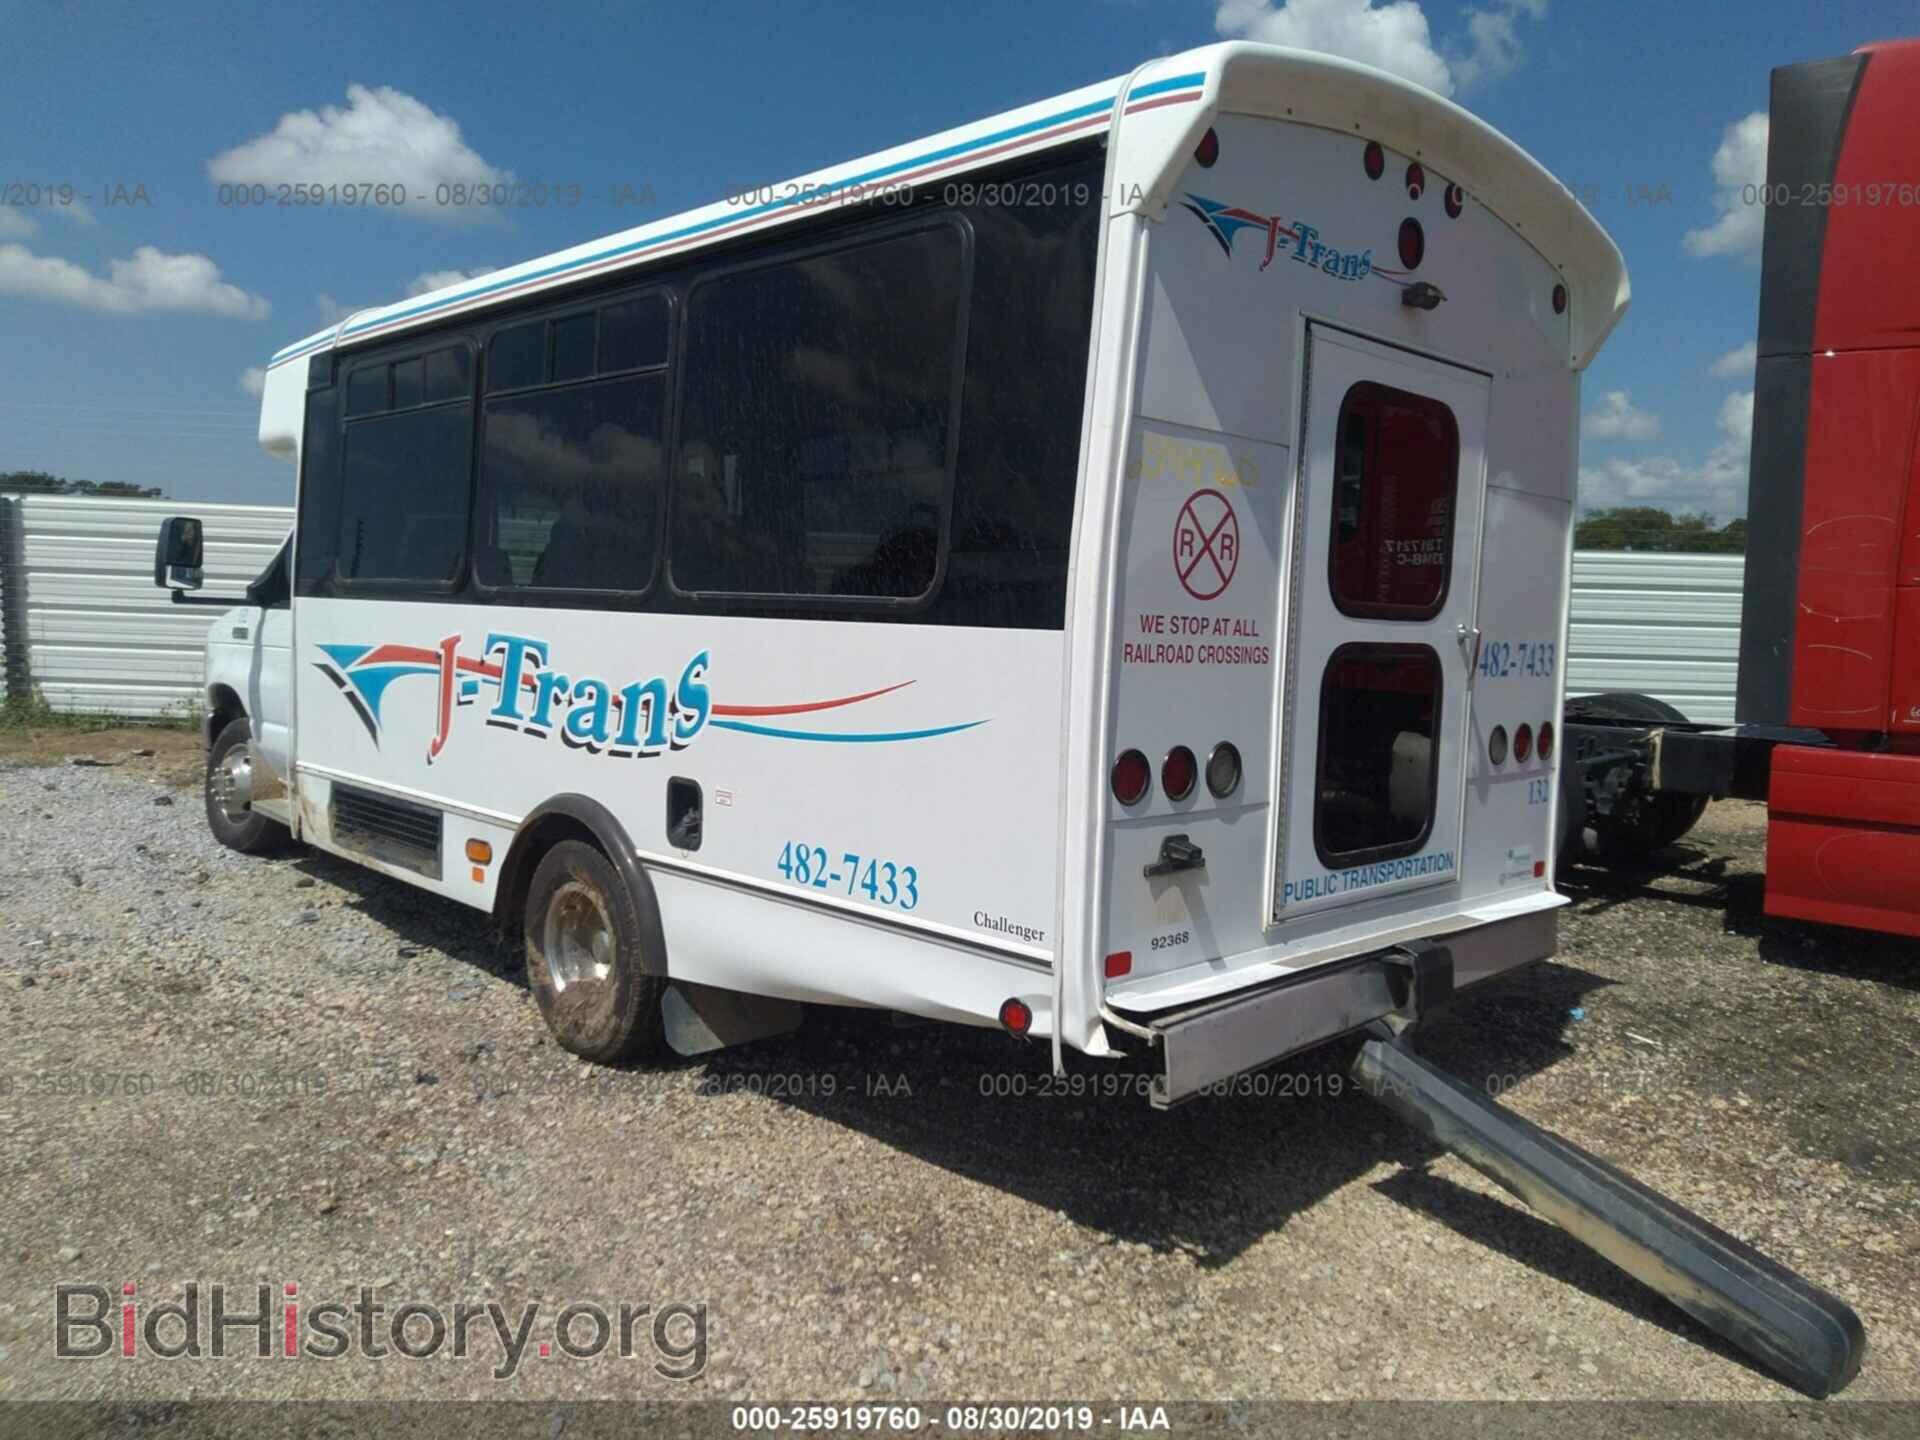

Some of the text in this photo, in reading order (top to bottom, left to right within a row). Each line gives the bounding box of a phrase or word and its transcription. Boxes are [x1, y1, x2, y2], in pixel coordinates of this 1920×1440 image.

[1259, 216, 1373, 280] J-Trans
[1179, 528, 1235, 561] R R
[1140, 614, 1259, 637] WE STOP AT ALL
[1124, 643, 1270, 664] RAILROAD CROSSINGS
[1478, 641, 1555, 678] 482-7433
[427, 632, 711, 763] J-Trans
[777, 840, 919, 910] 482-7433
[1284, 852, 1454, 904] PUBLIC TRANSPORTATION
[973, 911, 1046, 942] Challenger
[1151, 931, 1190, 950] 92368
